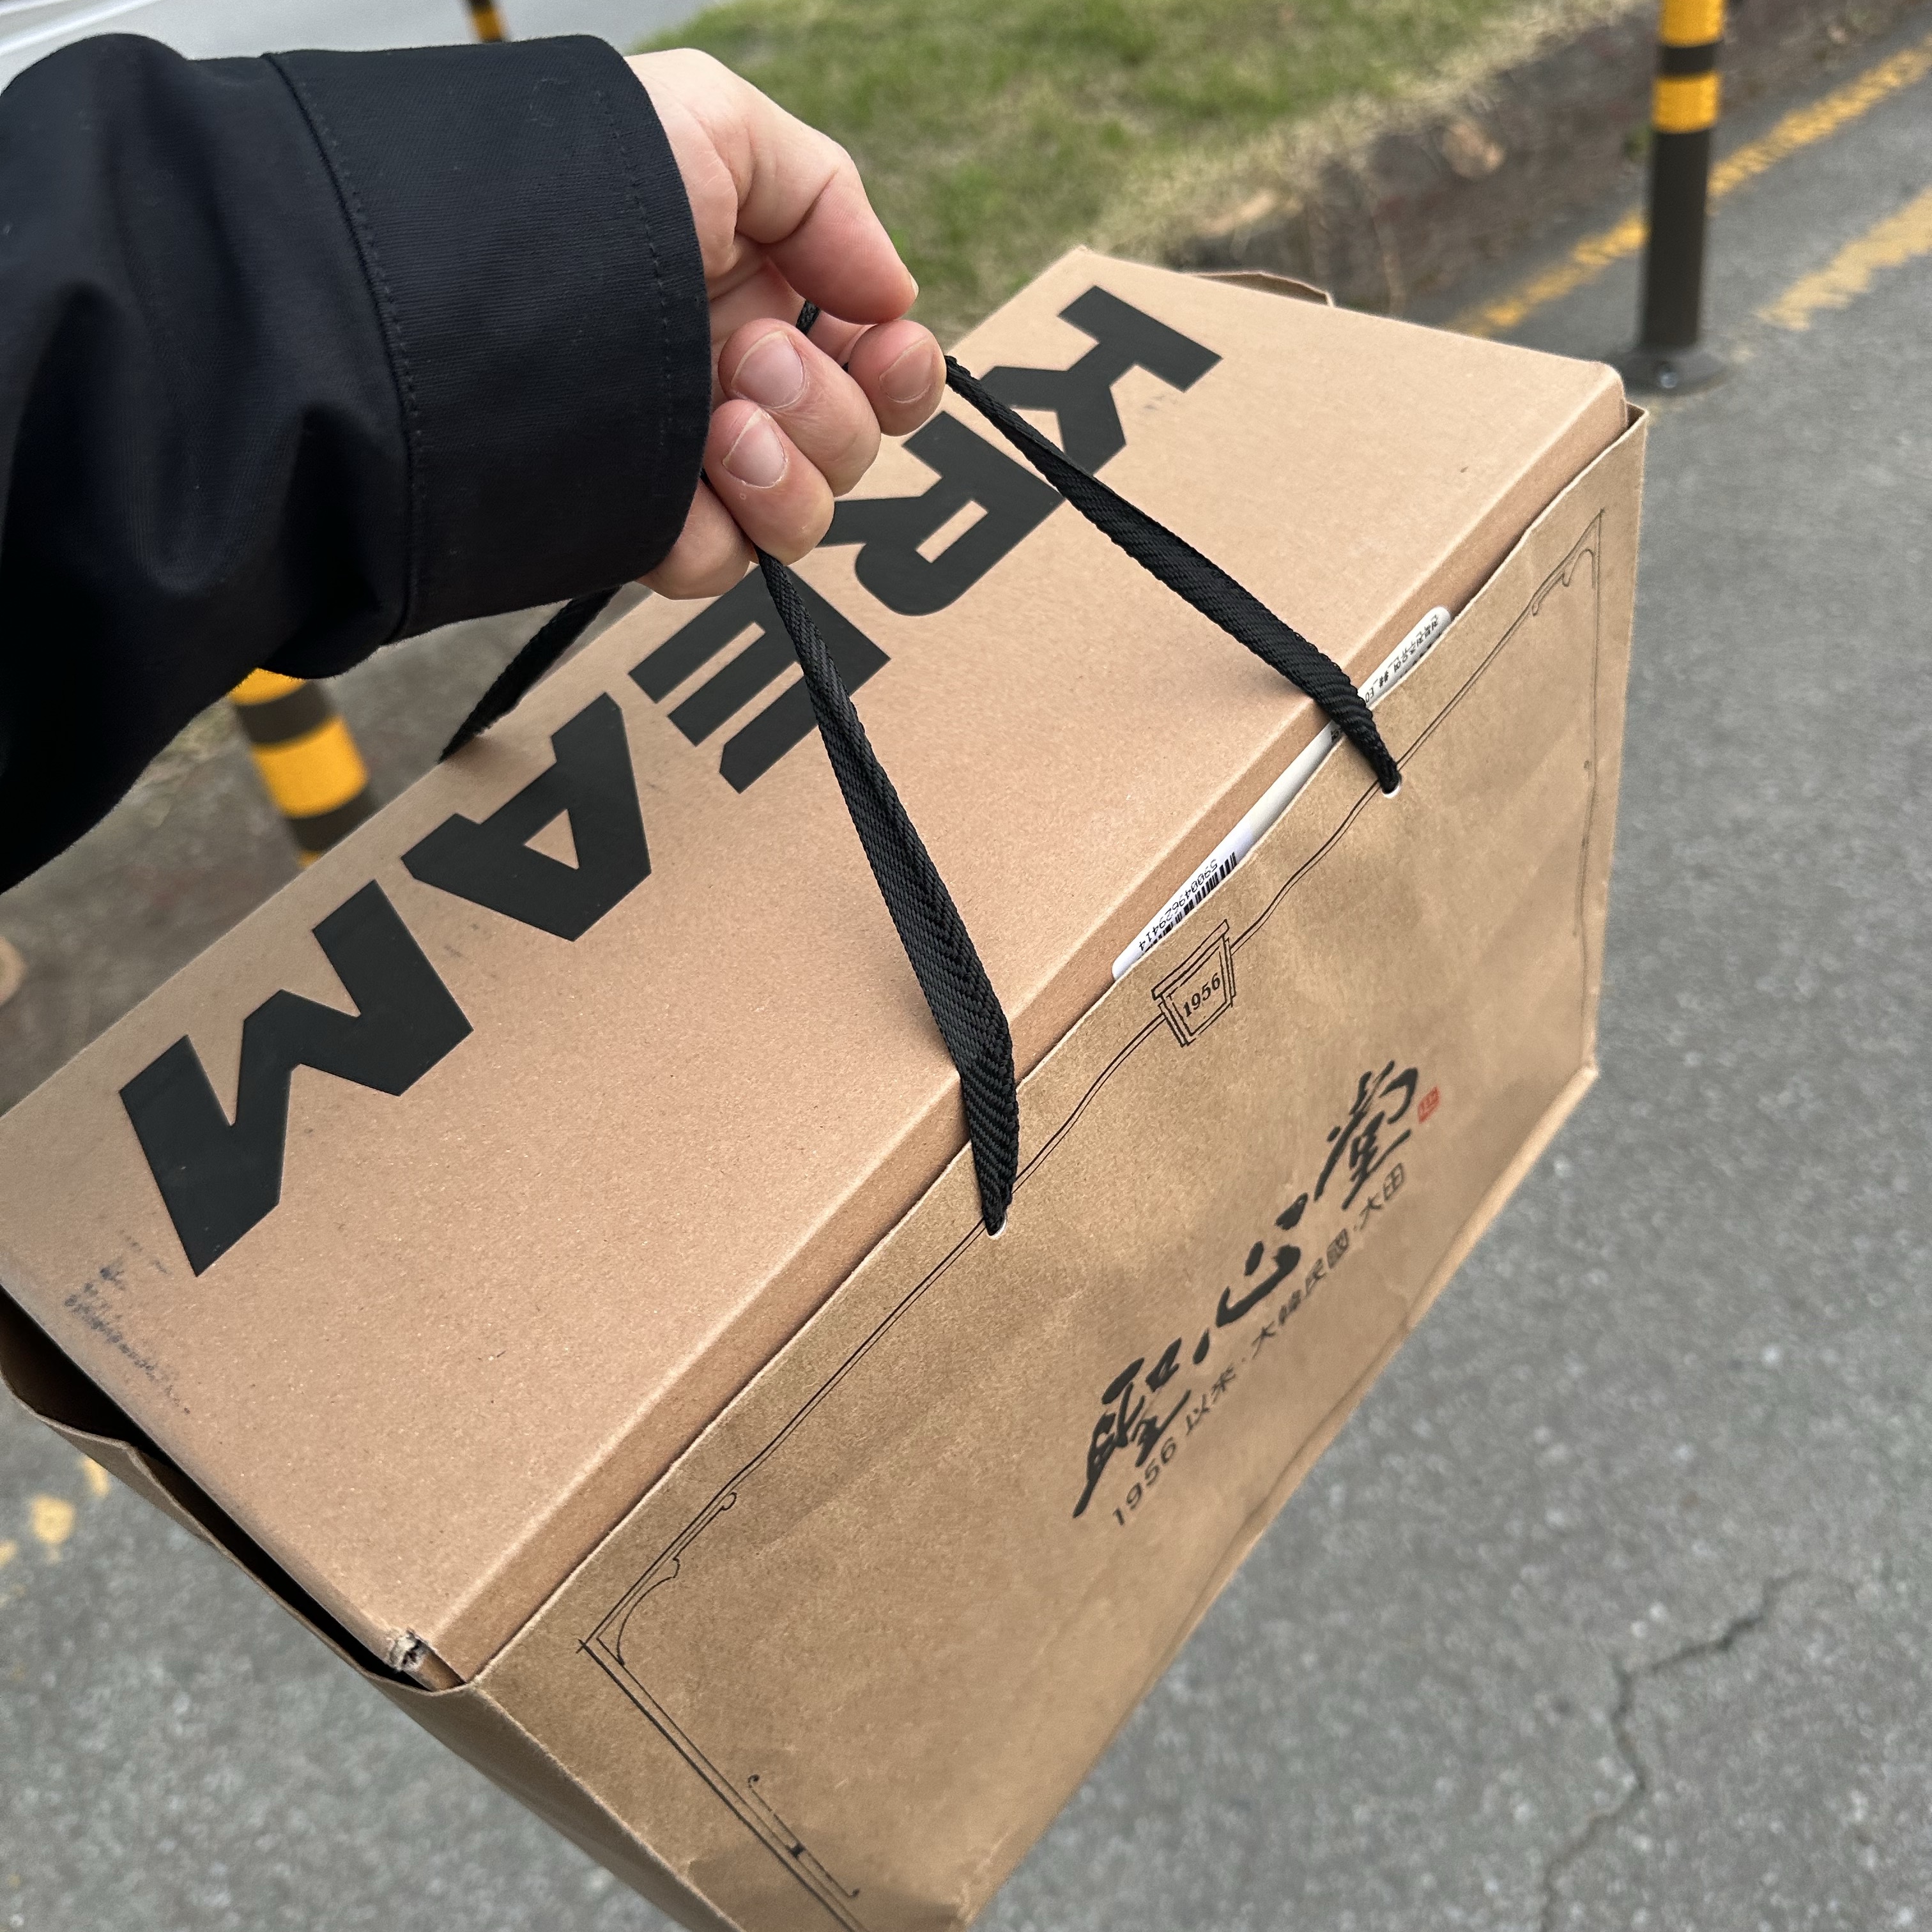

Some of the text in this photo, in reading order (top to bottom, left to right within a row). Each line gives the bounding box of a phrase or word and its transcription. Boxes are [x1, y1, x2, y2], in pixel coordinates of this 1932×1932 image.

[119, 285, 1222, 1276] KREAM
[1138, 858, 1218, 951] 590049629414
[1183, 972, 1221, 1018] 1956
[1073, 1060, 1418, 1519] 聖心堂
[1112, 1436, 1177, 1526] 1956
